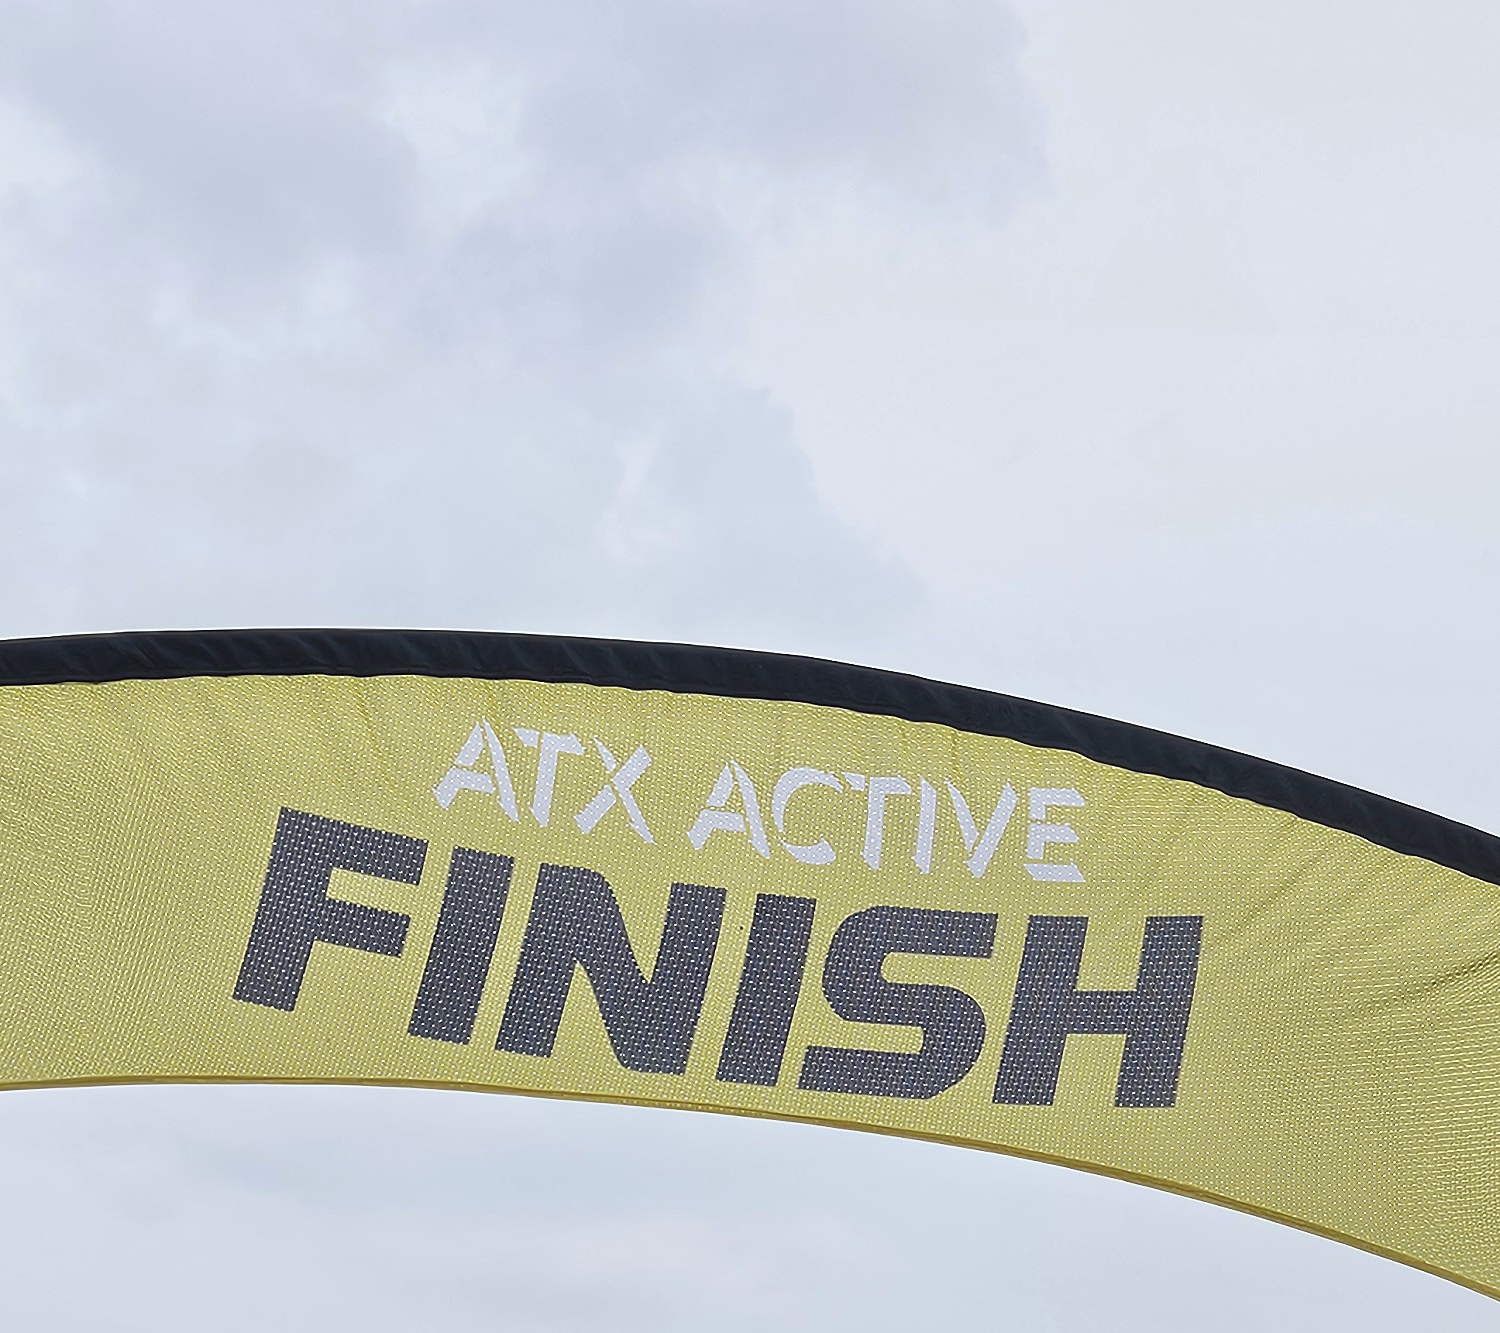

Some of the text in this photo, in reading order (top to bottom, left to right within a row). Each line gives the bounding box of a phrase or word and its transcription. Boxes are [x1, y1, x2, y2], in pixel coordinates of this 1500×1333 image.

[432, 716, 1086, 883] ATX ACTIVE
[232, 806, 1204, 1108] FINISH
